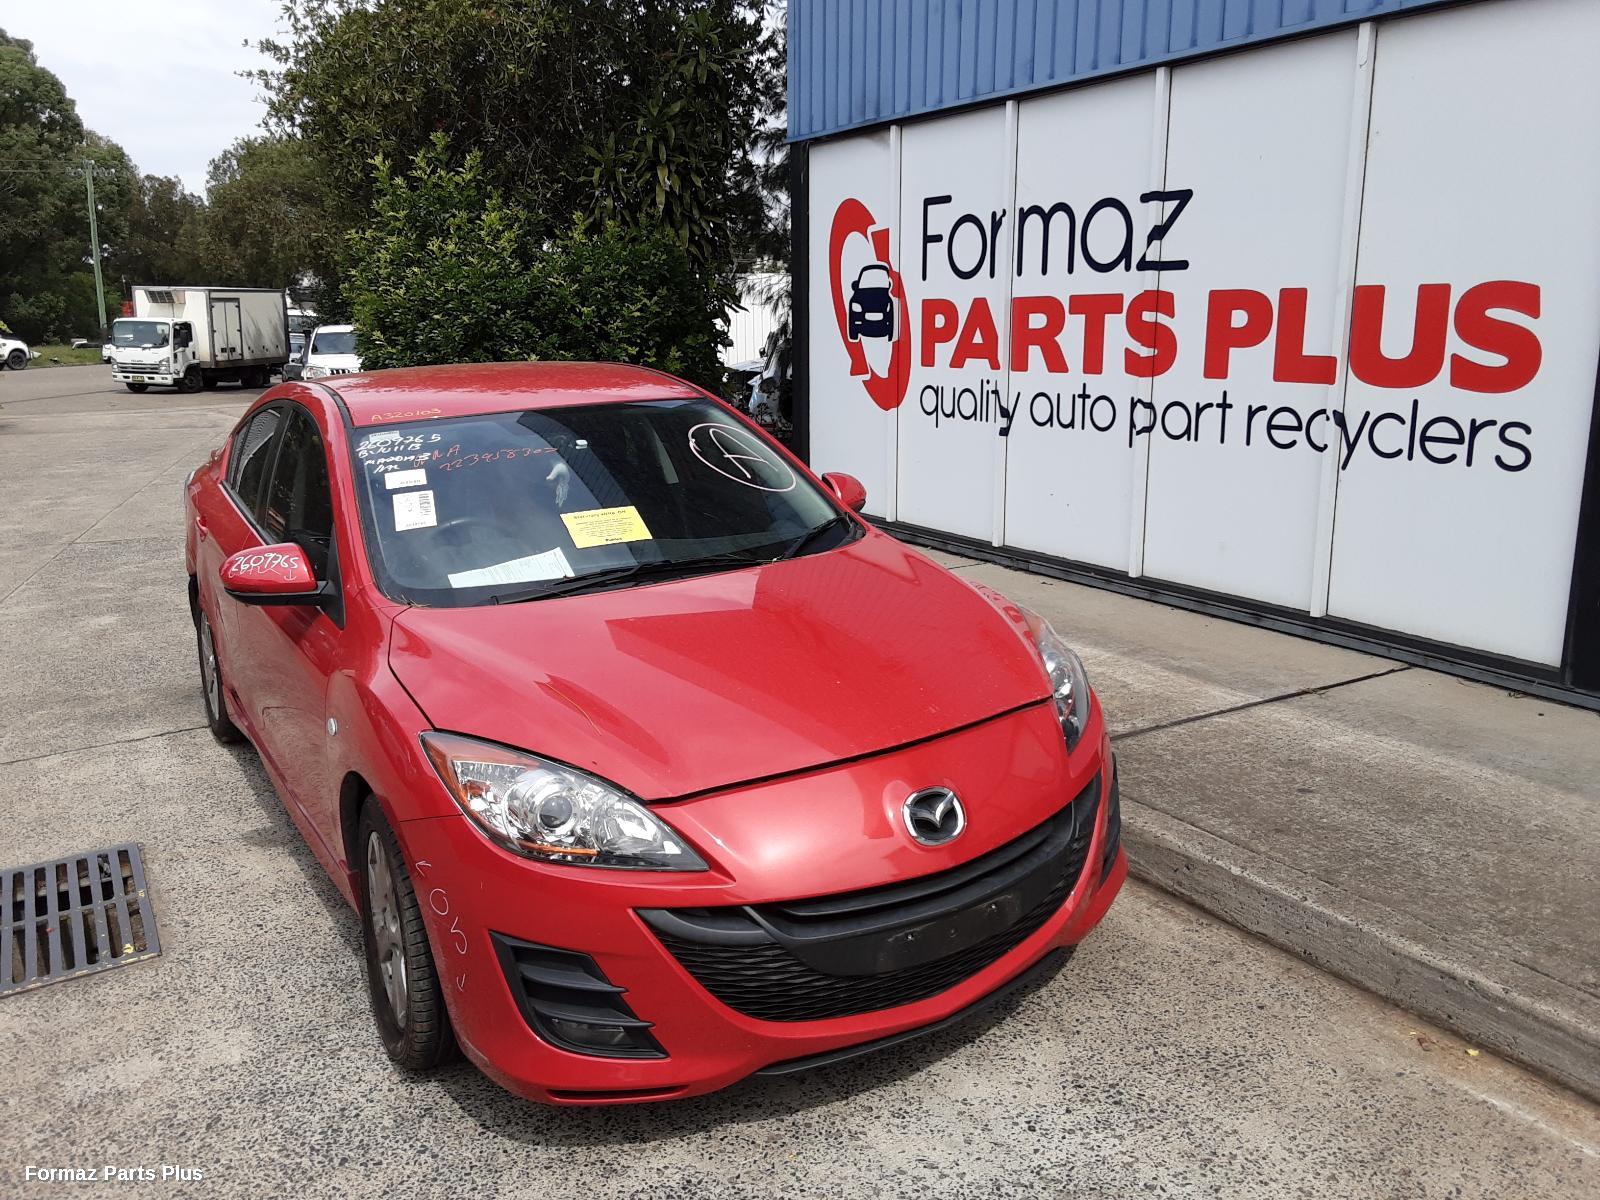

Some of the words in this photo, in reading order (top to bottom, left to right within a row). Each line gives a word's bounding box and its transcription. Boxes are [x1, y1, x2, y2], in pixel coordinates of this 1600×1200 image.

[920, 188, 1194, 282] Formaz
[920, 289, 1178, 379] PARTS
[1203, 280, 1543, 394] PLUS
[920, 378, 1021, 437] quality
[1029, 382, 1117, 432] auto
[1128, 390, 1234, 449] part
[1245, 398, 1533, 473] recyclers
